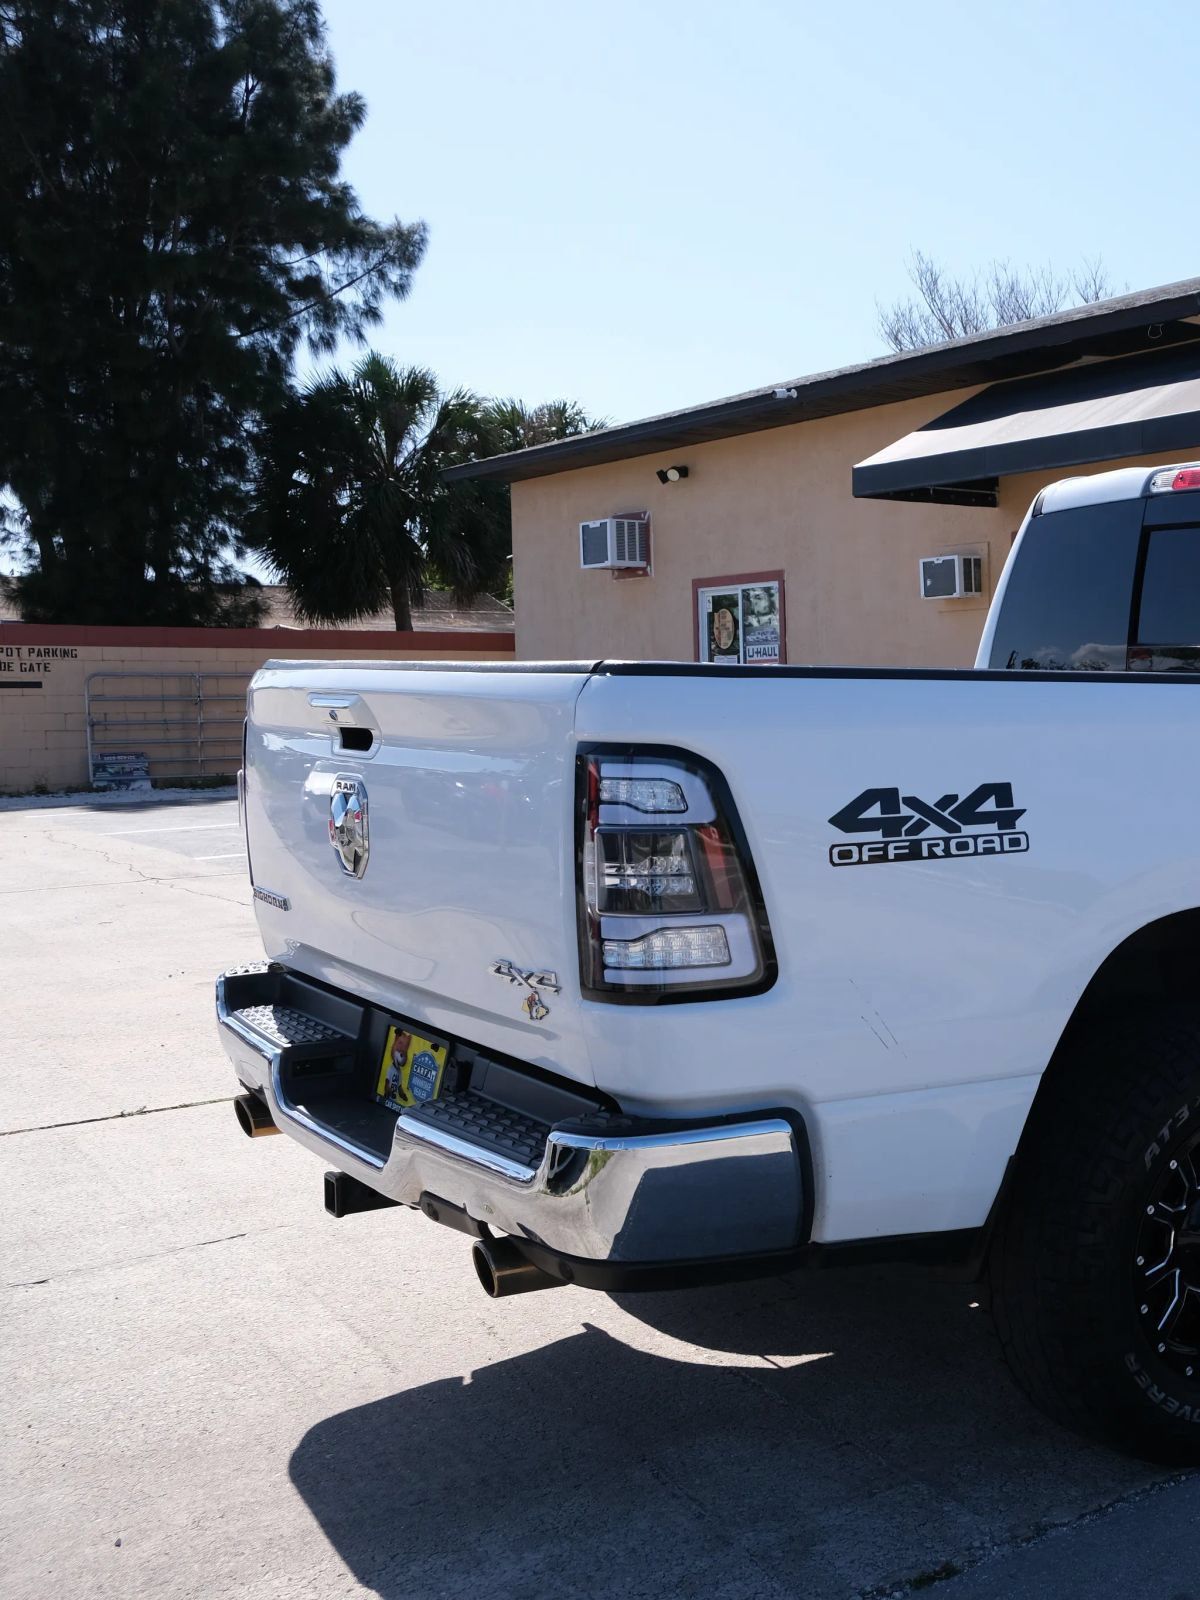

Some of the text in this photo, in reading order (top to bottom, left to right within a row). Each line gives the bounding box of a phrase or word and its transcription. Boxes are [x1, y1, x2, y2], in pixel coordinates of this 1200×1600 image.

[28, 647, 78, 658] PARKING
[20, 662, 51, 672] GATE
[336, 781, 356, 791] RAM
[832, 833, 1028, 864] OFF ROAD
